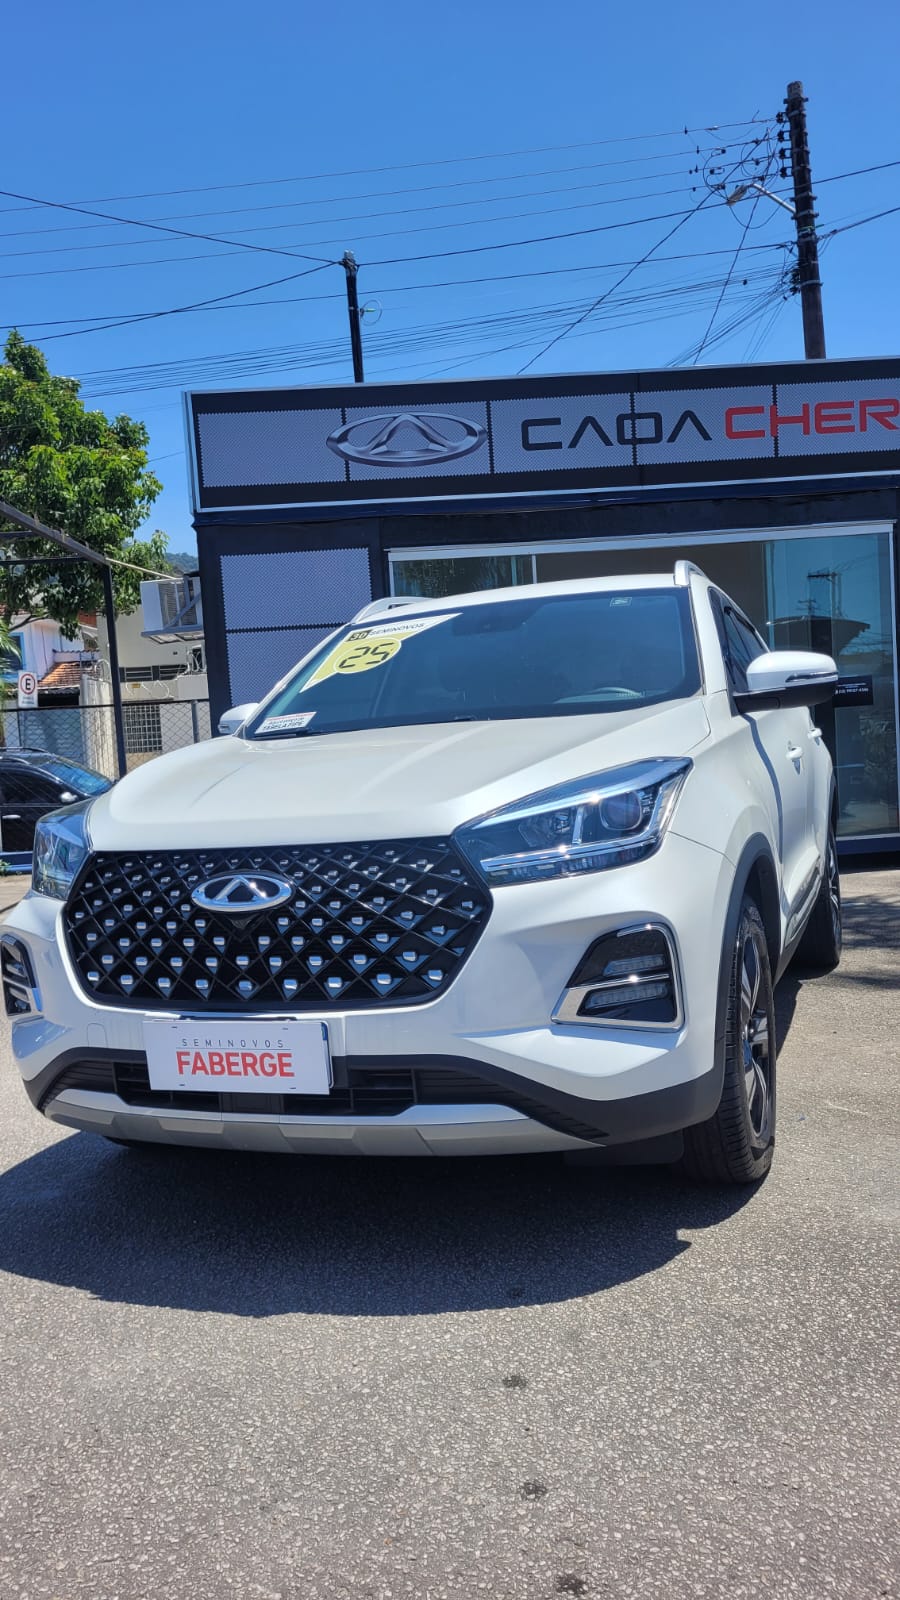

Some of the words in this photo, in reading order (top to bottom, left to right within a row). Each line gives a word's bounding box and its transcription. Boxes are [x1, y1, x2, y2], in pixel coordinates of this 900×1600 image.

[521, 410, 712, 451] CAOA
[339, 642, 395, 668] 25
[25, 678, 31, 690] E
[181, 1038, 284, 1048] SEMINOVOS
[176, 1051, 294, 1077] FABERGE
